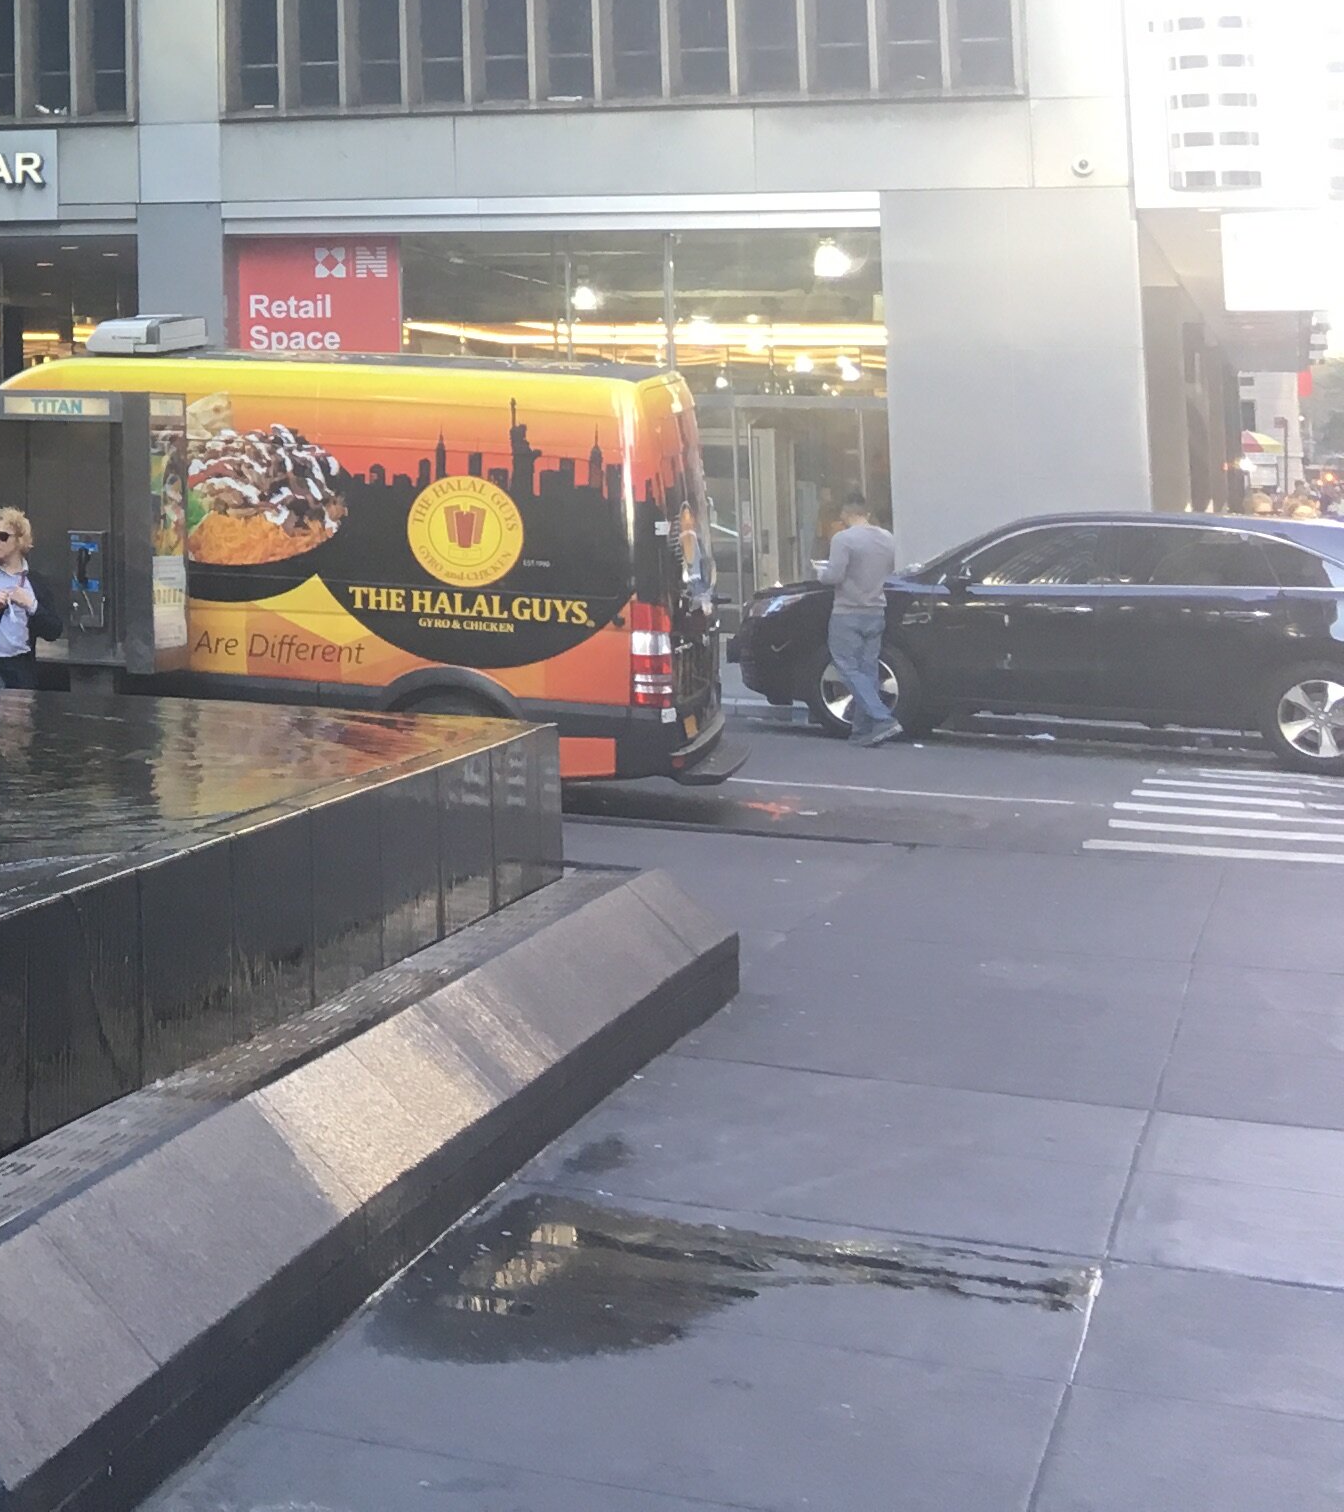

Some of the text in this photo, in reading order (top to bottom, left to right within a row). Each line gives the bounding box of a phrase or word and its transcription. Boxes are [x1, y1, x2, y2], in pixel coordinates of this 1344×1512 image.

[249, 294, 332, 319] Retail
[250, 325, 341, 351] Space
[31, 399, 82, 414] TITAN
[412, 479, 519, 532] THE HALAL GUYS
[418, 545, 444, 572] GYRO
[466, 551, 512, 581] CHICKEN
[348, 586, 406, 612] THE
[410, 589, 508, 619] HALAL
[418, 617, 515, 633] GYRO & CHICKEN
[194, 630, 365, 665] Are Different
